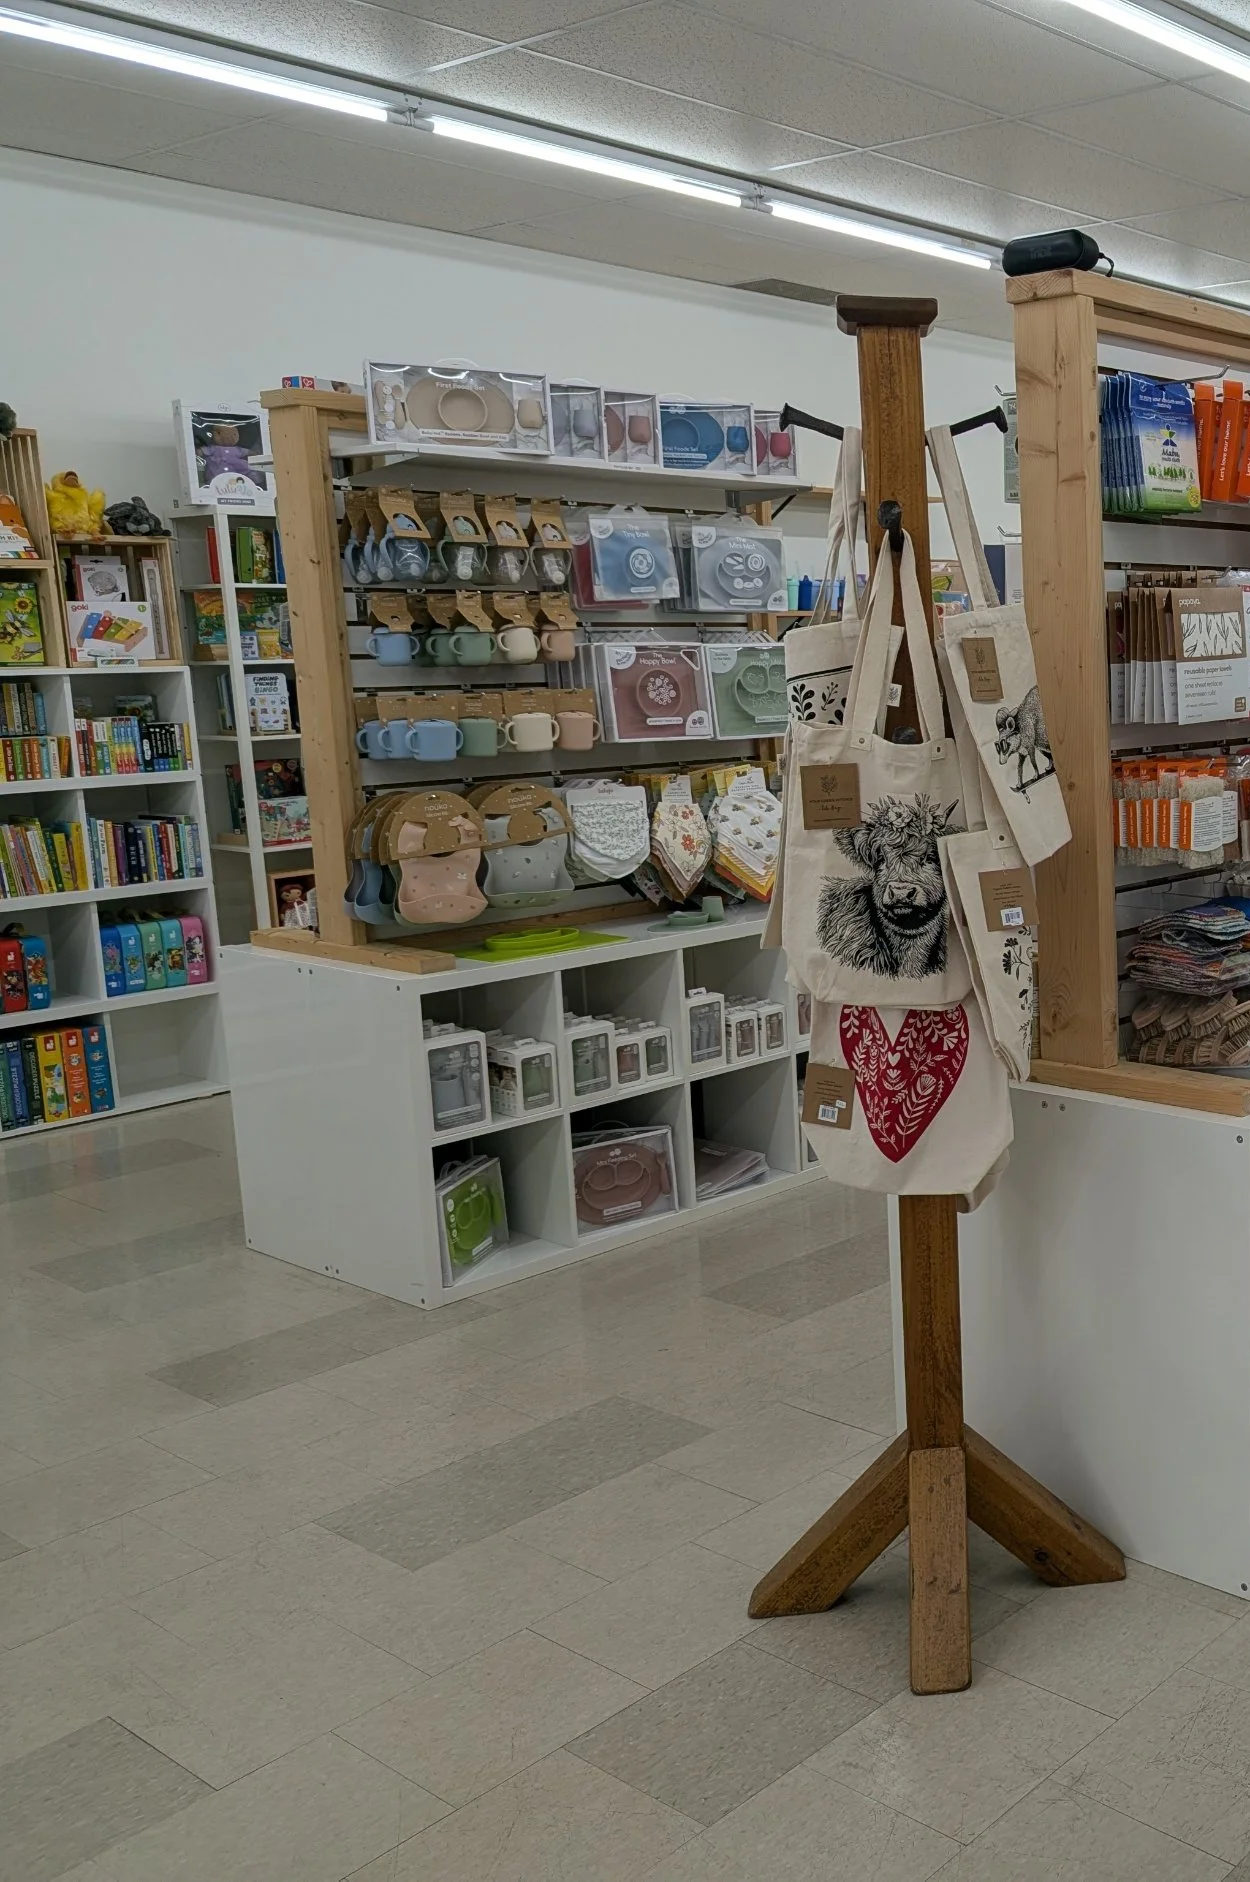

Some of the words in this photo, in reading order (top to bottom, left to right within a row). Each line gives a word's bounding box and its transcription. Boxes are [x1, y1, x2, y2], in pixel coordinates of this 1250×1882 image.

[635, 530, 650, 538] Bowl
[70, 604, 88, 612] goki
[639, 657, 660, 666] Happy
[661, 657, 677, 665] Bowl
[1183, 667, 1206, 675] reusable
[1206, 667, 1219, 675] paper
[254, 686, 279, 694] BINGO
[424, 803, 448, 811] nouka
